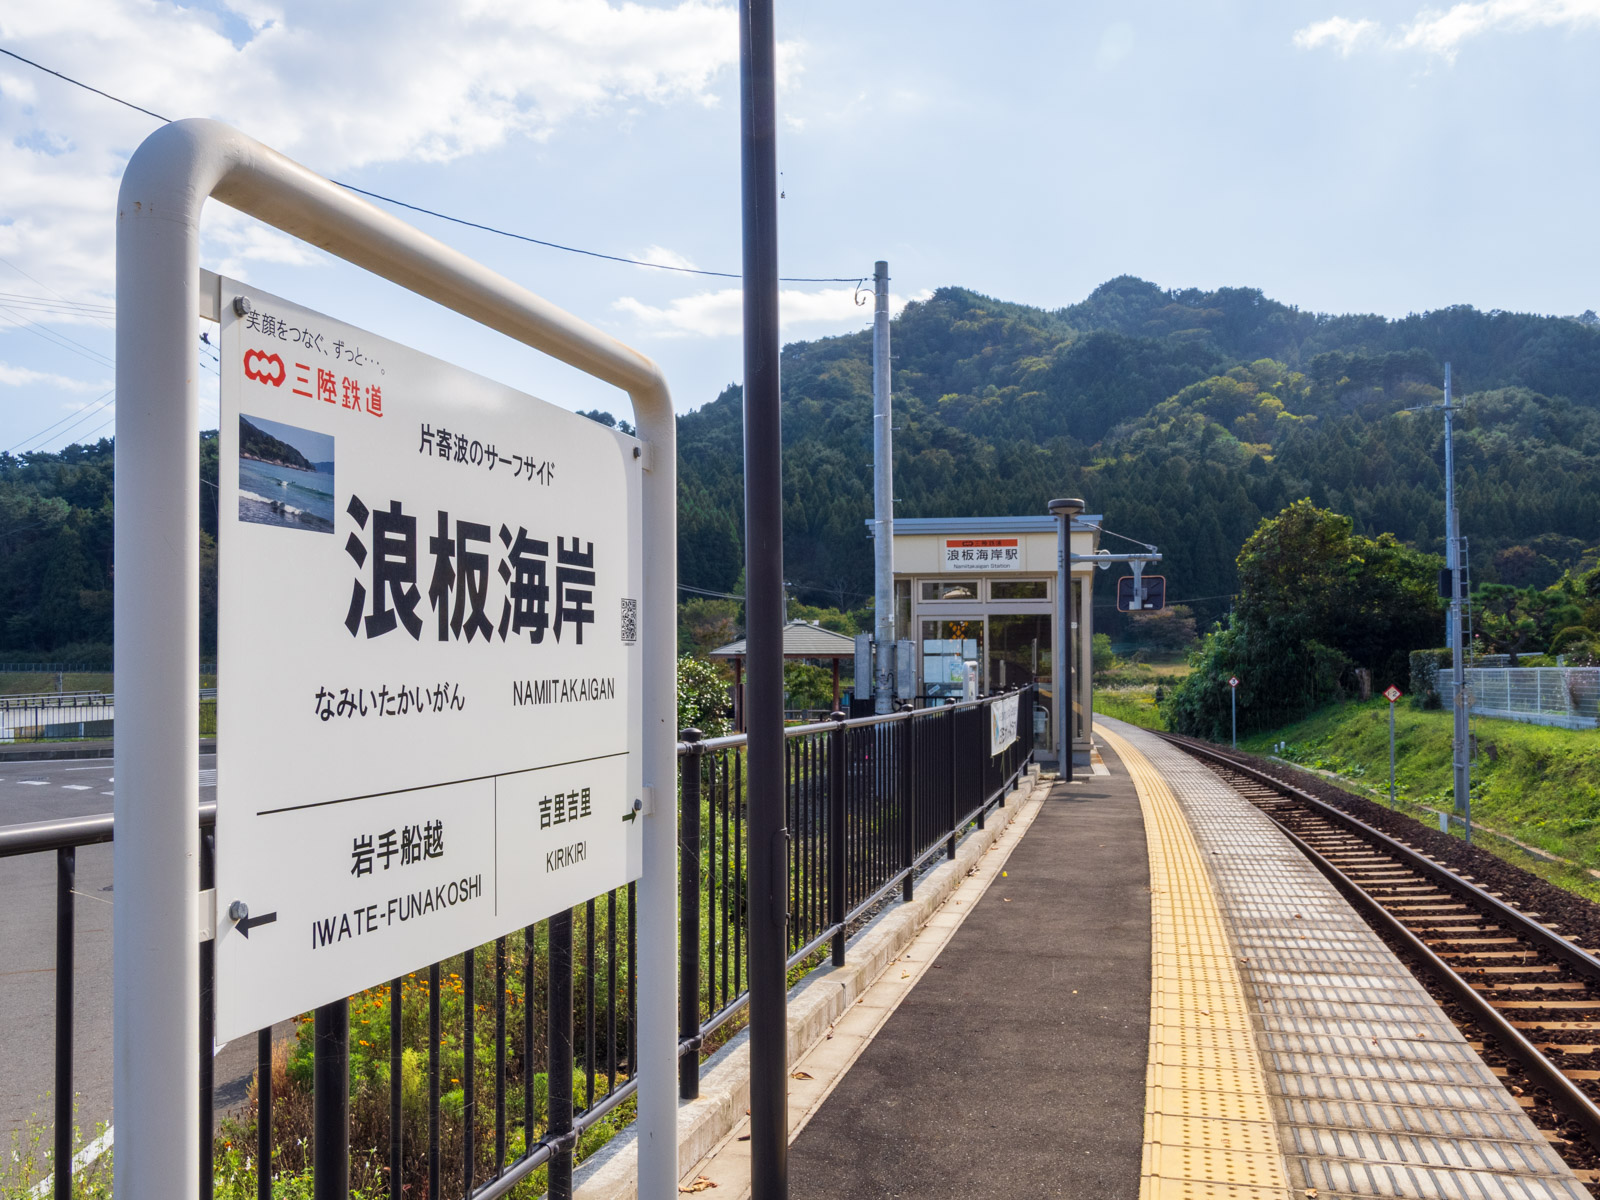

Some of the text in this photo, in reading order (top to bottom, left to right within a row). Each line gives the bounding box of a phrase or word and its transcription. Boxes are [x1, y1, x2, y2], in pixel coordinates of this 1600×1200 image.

[292, 362, 383, 418] 三陸鉄道
[419, 423, 556, 486] 片寄波のサーフサイド
[344, 494, 596, 645] 浪板海岸
[947, 548, 1018, 561] 浪板海岸駅
[315, 681, 465, 722] なみいたかいがん
[513, 677, 615, 706] NAMIITAKAIGAN
[538, 787, 592, 830] 吉里吉里
[351, 819, 444, 878] 岩手船越
[546, 840, 587, 873] KIRIKIRI
[312, 873, 482, 950] IWATE-FUNAKOSHI
